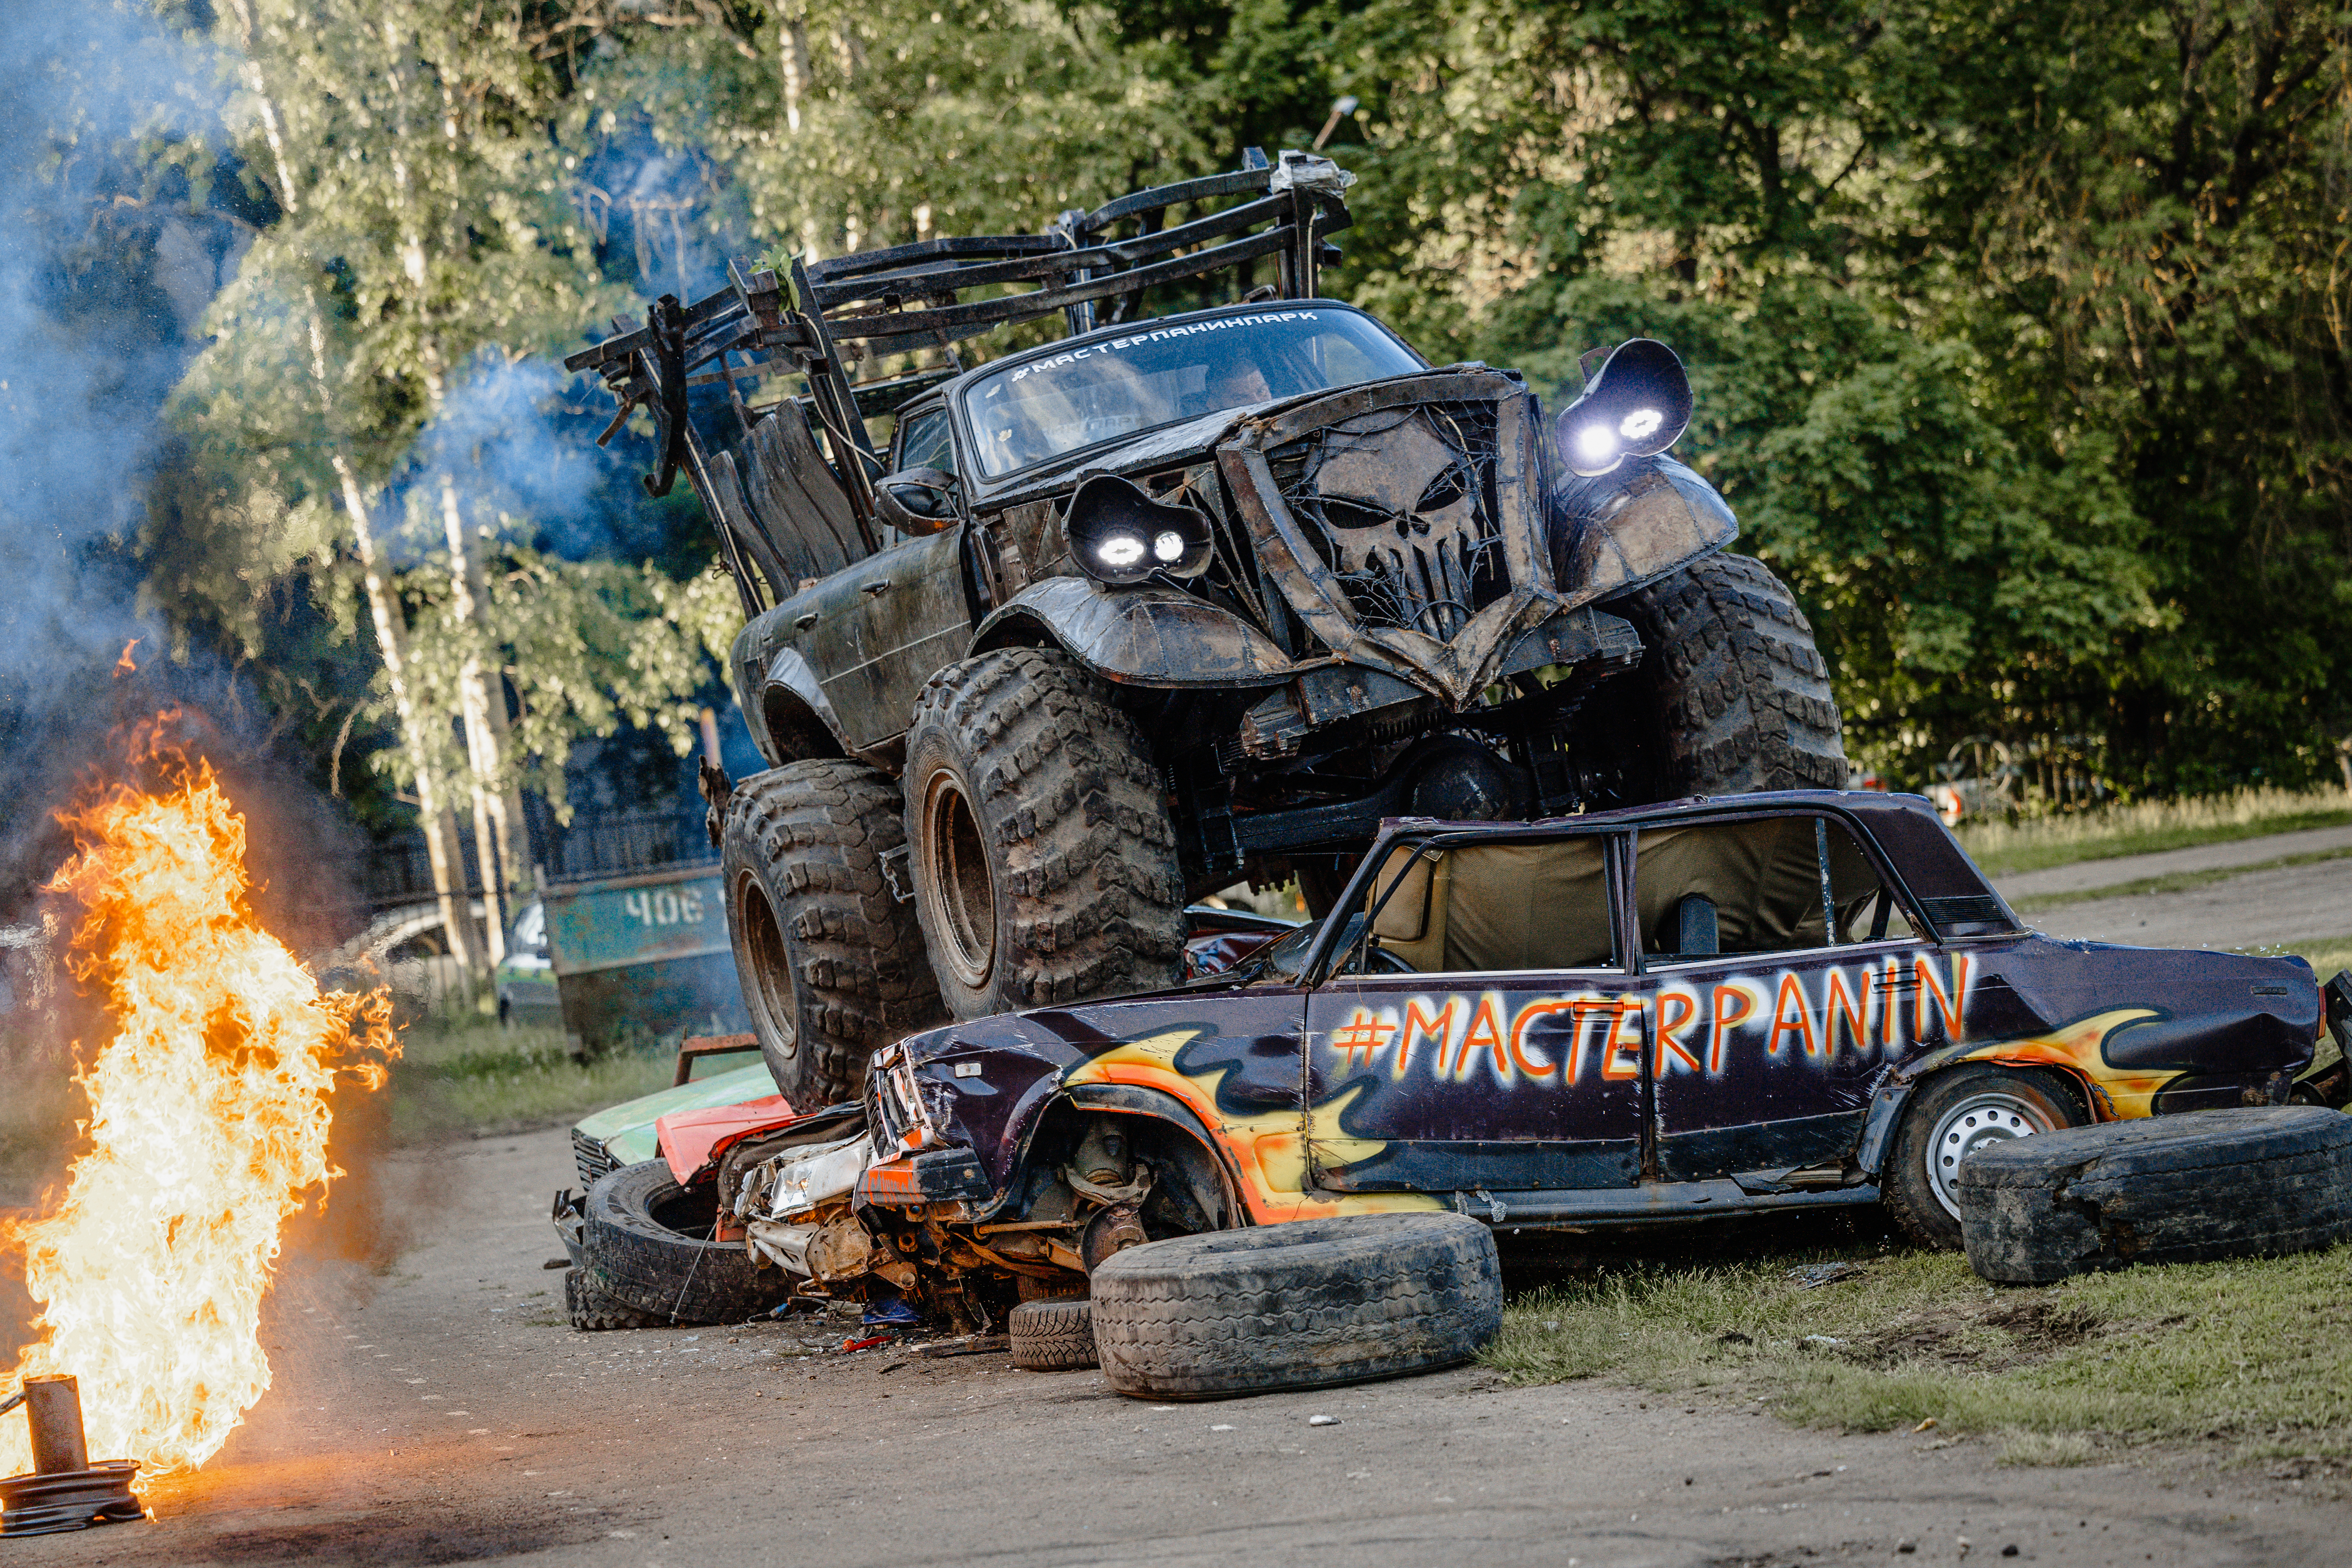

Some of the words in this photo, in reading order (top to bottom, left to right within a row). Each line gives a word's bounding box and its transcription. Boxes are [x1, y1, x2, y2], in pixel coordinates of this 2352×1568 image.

[1011, 311, 1318, 383] #МАСТЕРПАНИНПАРК
[625, 887, 705, 926] 406
[1331, 953, 1971, 1085] #MACTERPANIN
